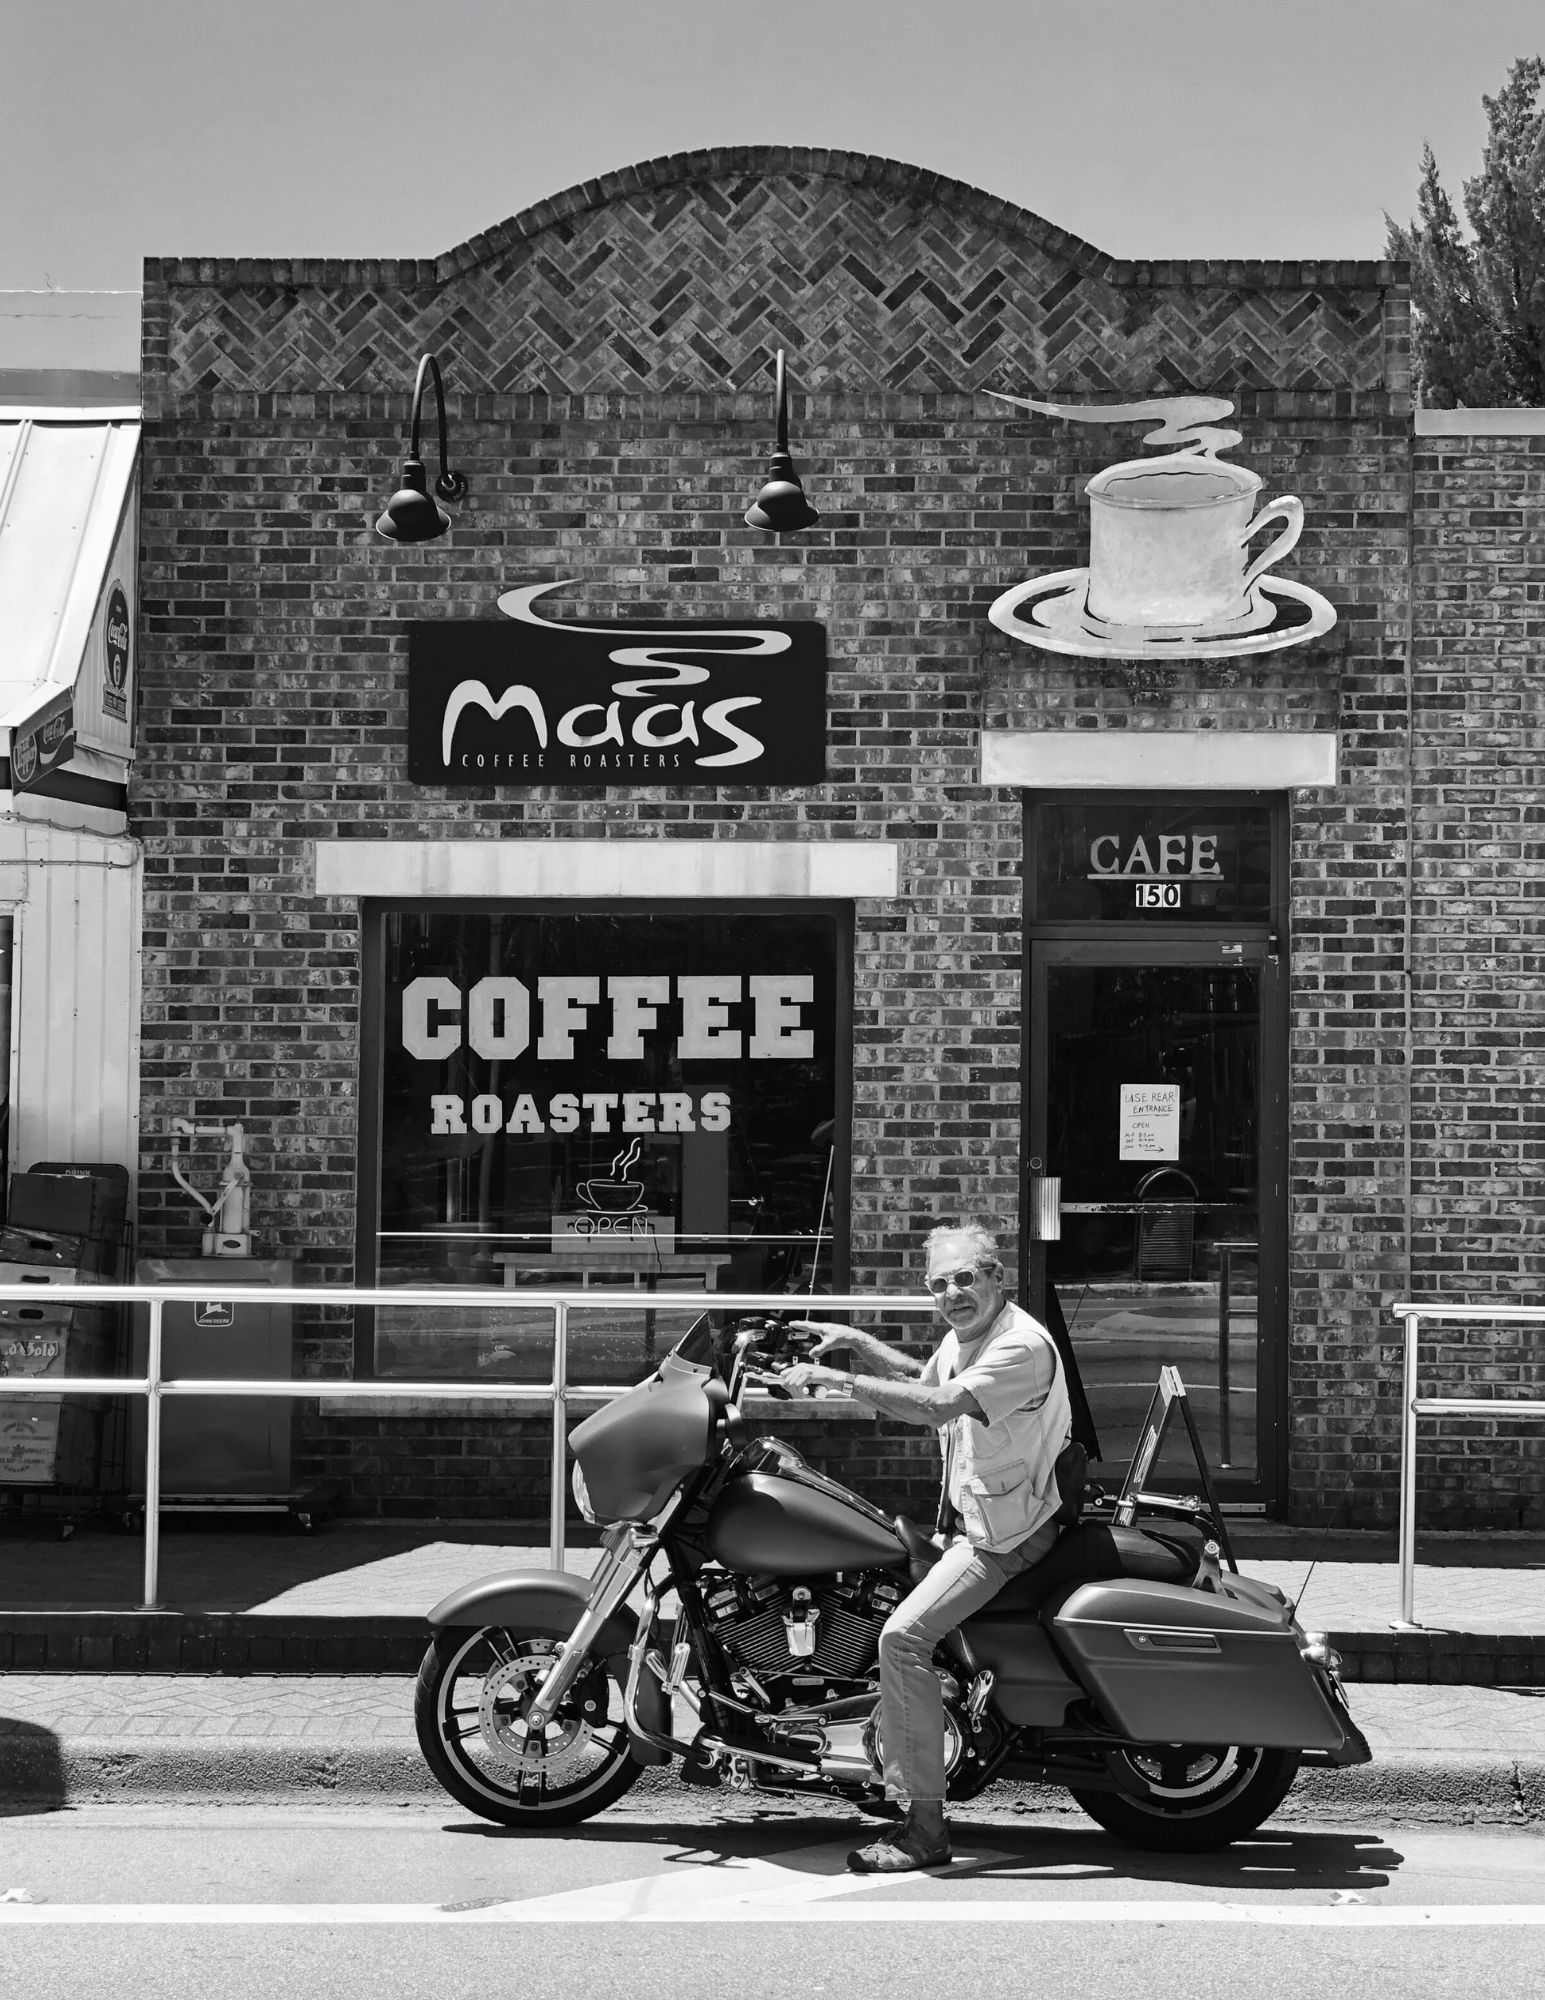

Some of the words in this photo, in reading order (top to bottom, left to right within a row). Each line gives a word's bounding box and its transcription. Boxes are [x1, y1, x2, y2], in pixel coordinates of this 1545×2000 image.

[442, 679, 765, 767] Maas
[462, 753, 545, 768] COFFEE
[570, 753, 680, 768] ROASTERS
[1090, 834, 1221, 874] CAFE
[1136, 885, 1179, 907] 150
[402, 975, 814, 1060] COFFEE
[1124, 1093, 1148, 1103] USE
[1151, 1092, 1176, 1103] REAR
[430, 1092, 732, 1135] ROASTERS
[1133, 1104, 1173, 1114] ENTRANCE
[574, 1216, 648, 1237] OPEN
